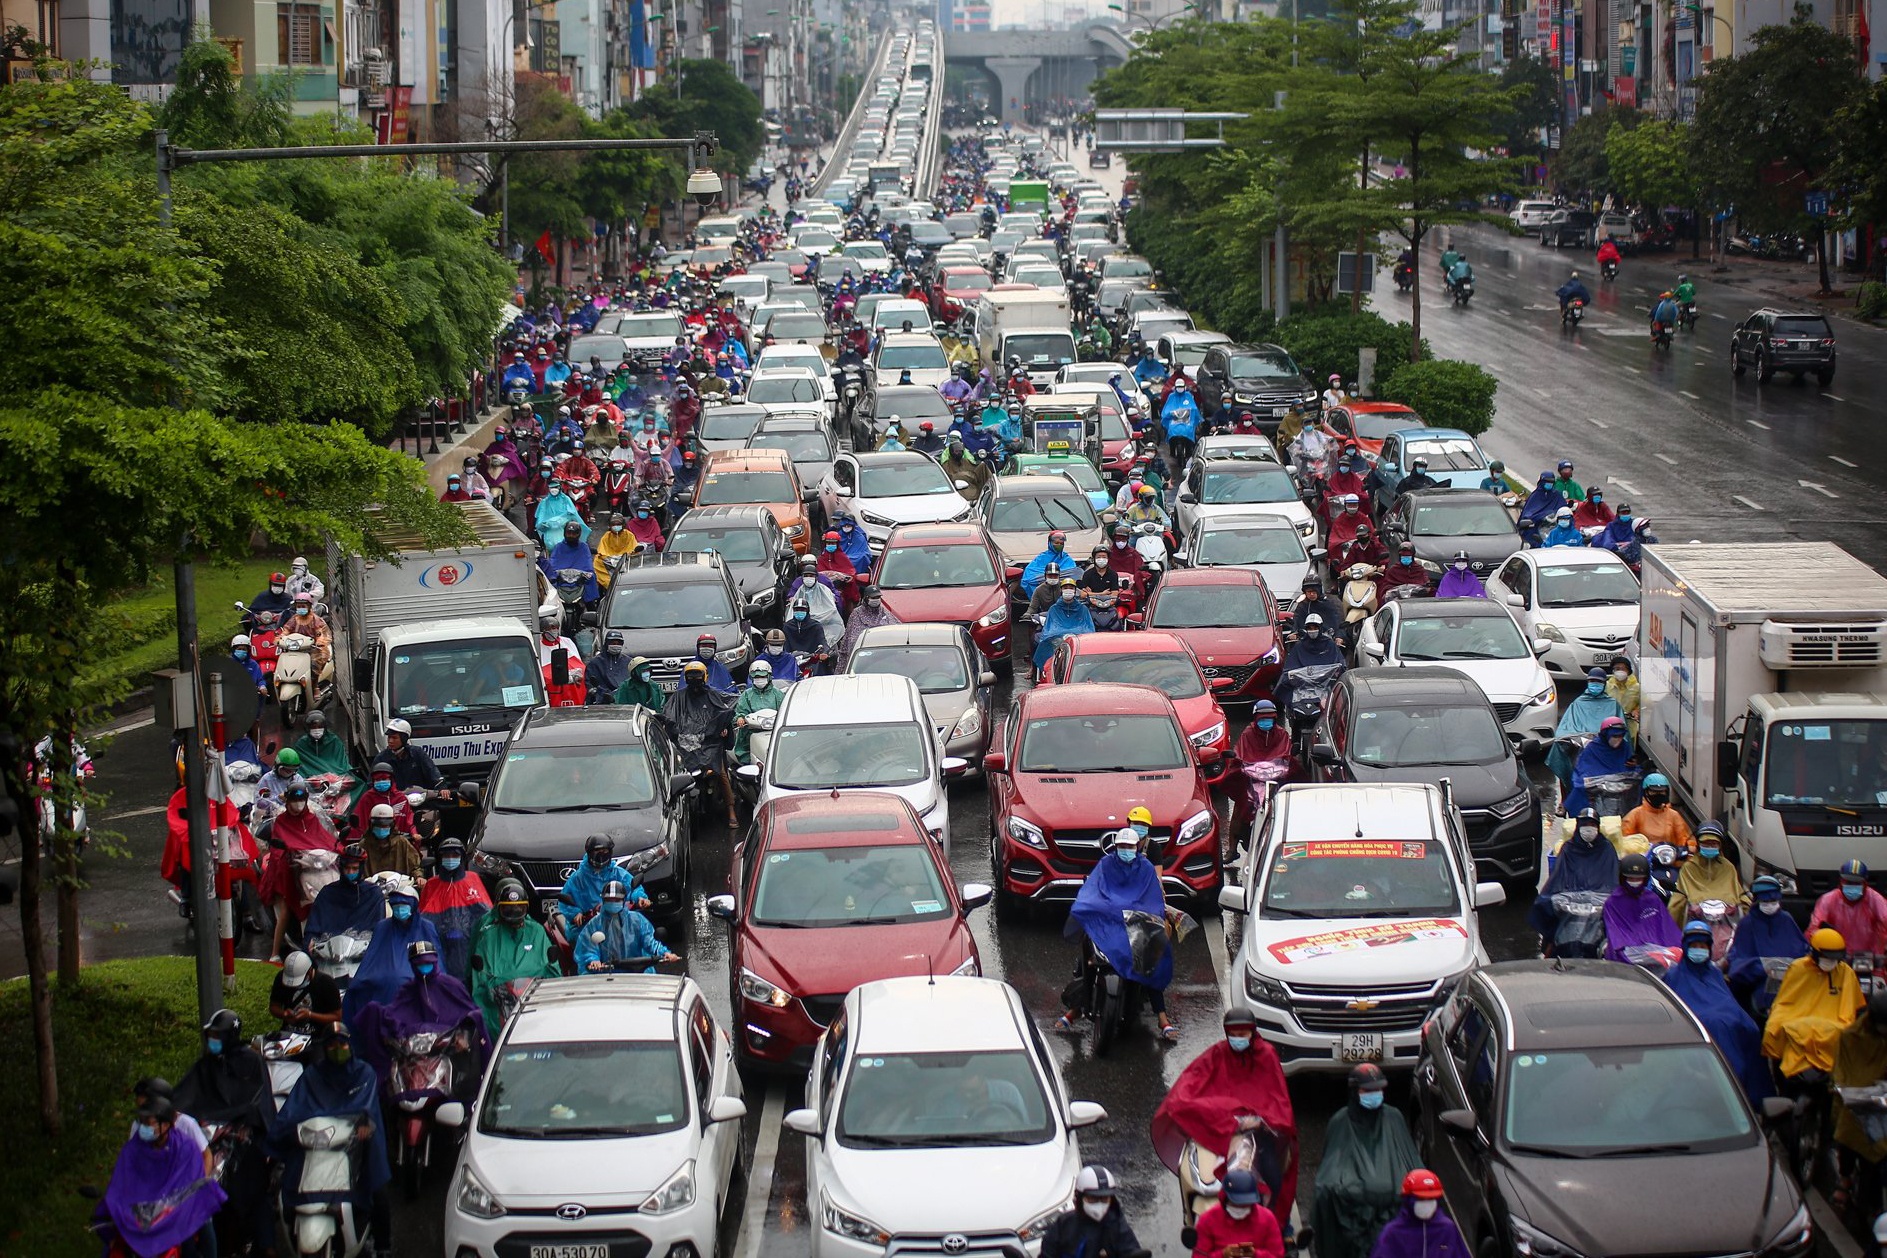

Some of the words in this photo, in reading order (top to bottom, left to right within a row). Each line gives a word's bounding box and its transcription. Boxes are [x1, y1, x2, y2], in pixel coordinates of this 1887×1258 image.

[1649, 612, 1663, 643] ABA
[451, 724, 491, 735] ISUZU
[422, 744, 460, 760] Phuong
[463, 742, 481, 756] Thu
[1837, 825, 1884, 835] ISUZU
[1352, 1035, 1374, 1047] 29H
